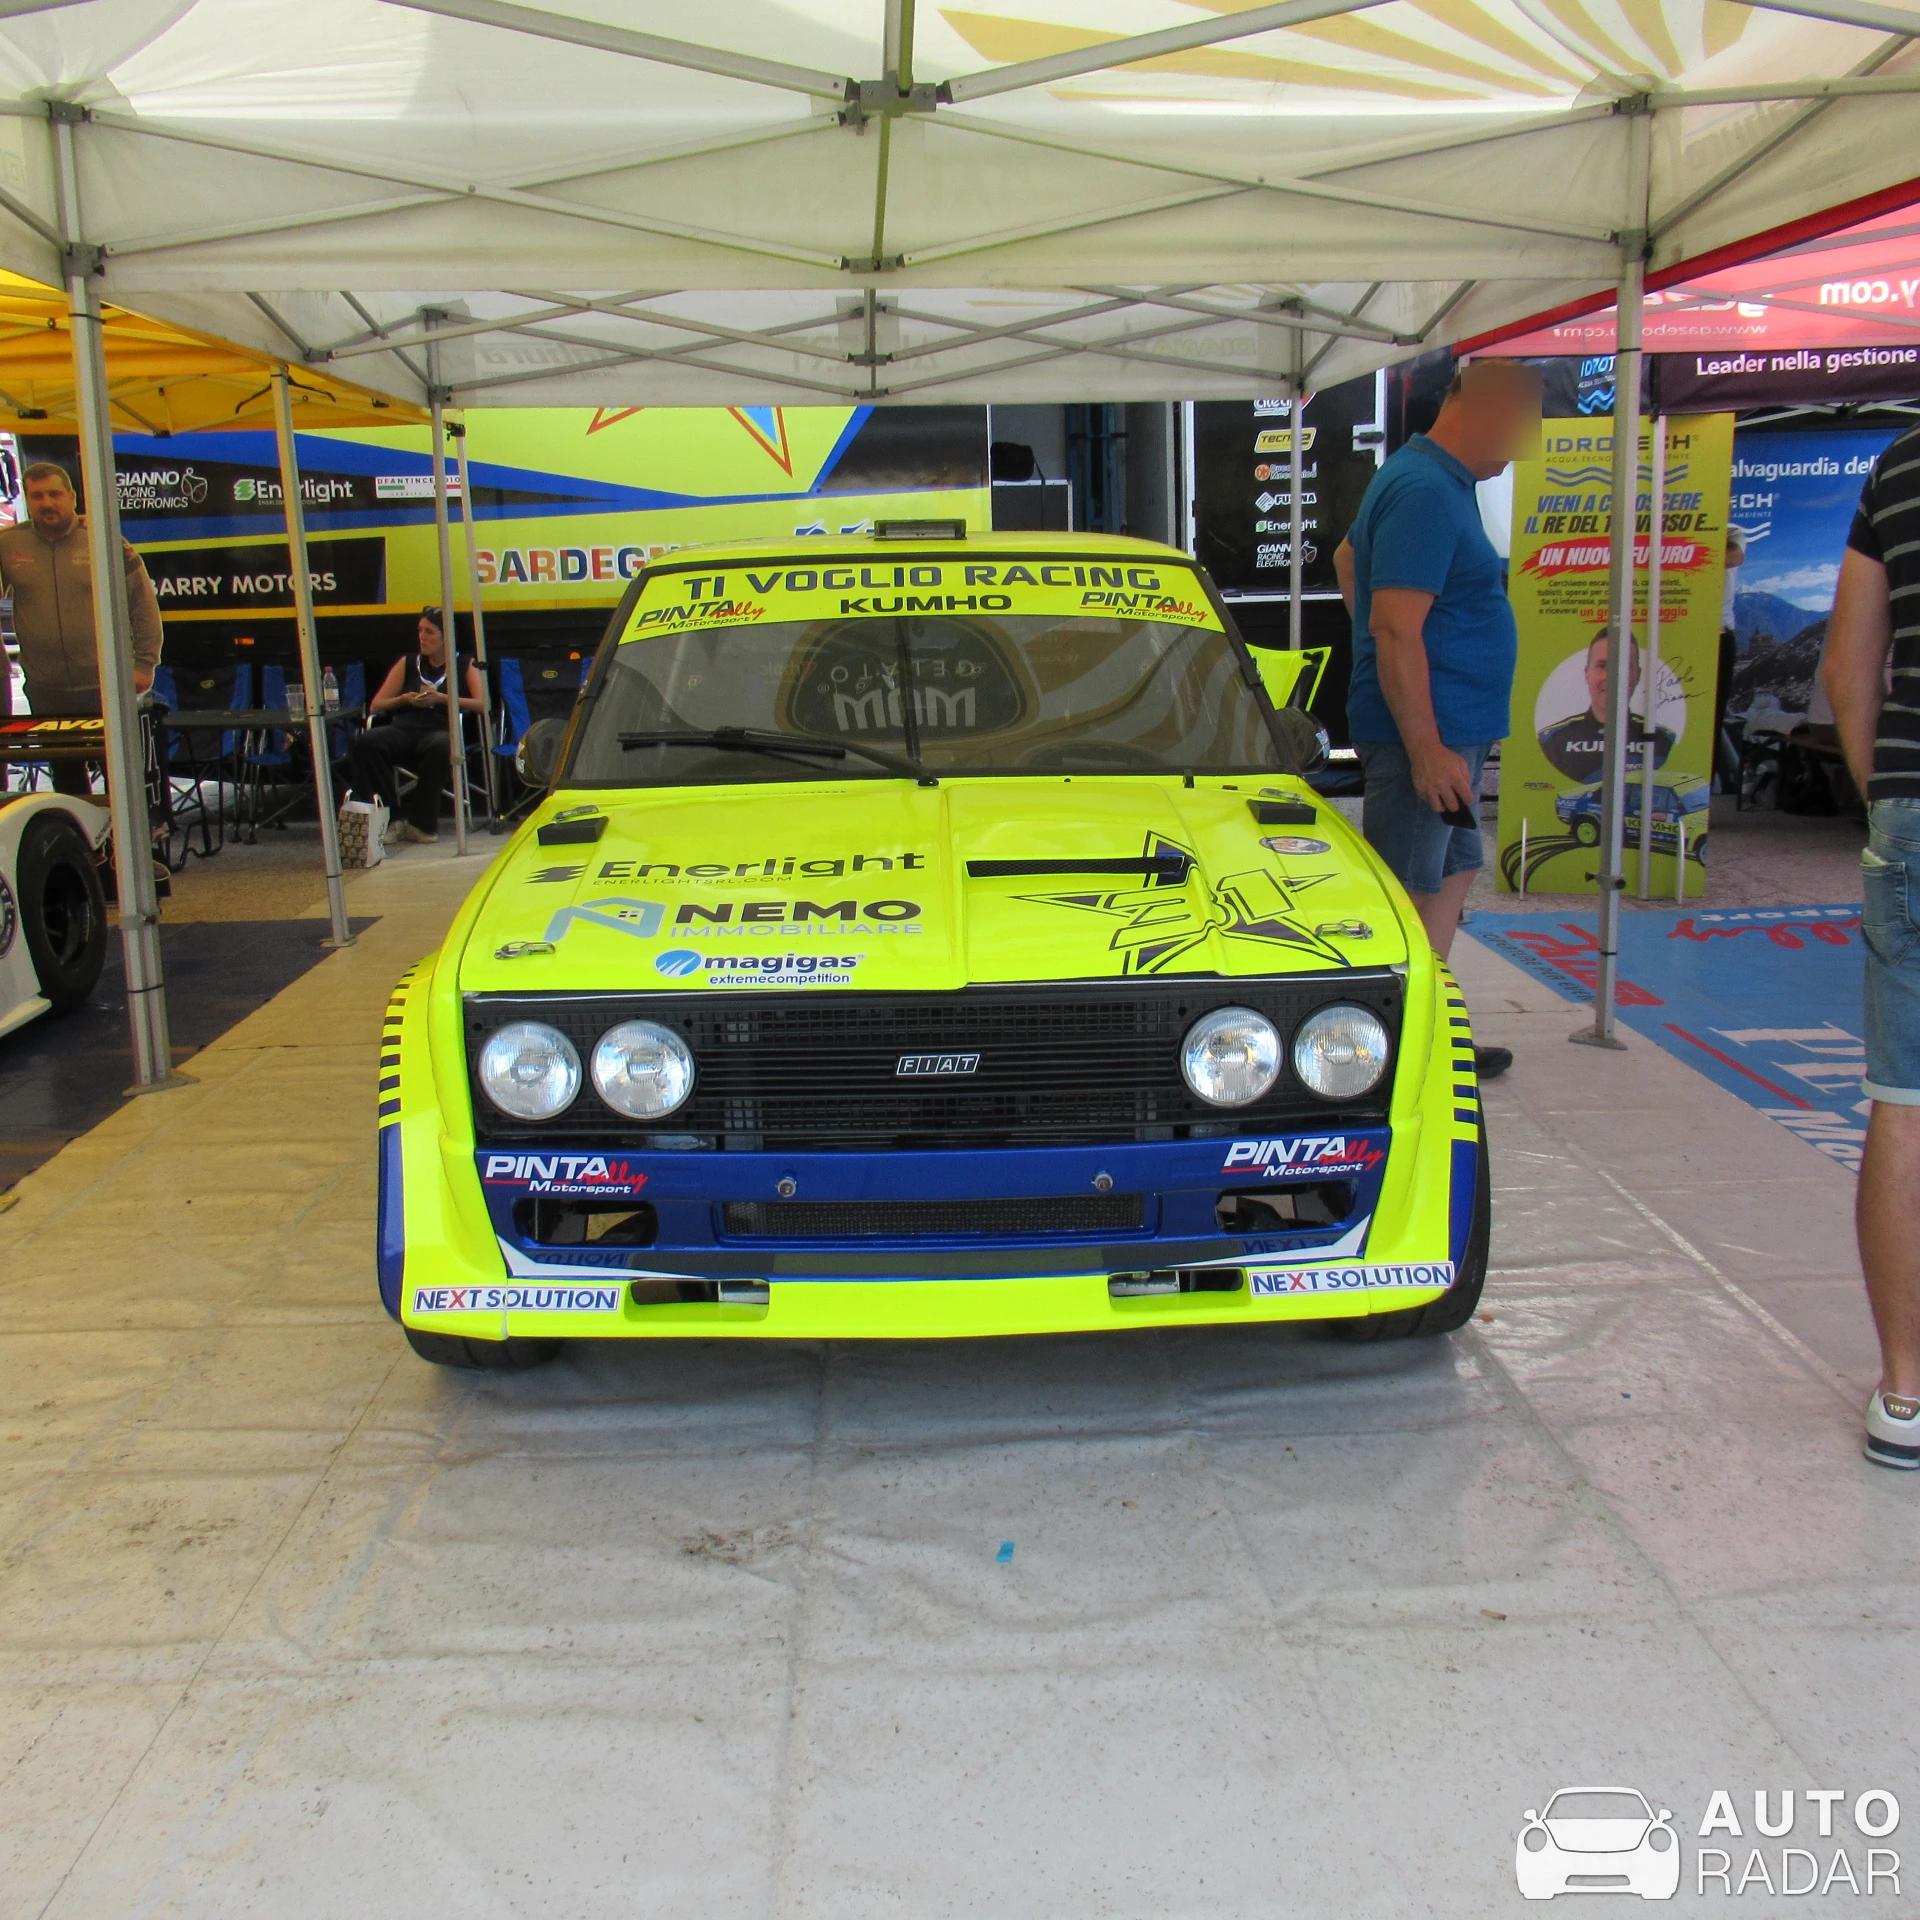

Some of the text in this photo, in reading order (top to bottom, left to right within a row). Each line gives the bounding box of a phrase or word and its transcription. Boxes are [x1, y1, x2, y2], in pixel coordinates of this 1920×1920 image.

[1697, 346, 1917, 377] Leader nella gestione
[1546, 435, 1691, 453] IDROEH
[1844, 455, 1880, 475] del
[115, 471, 180, 487] GIANNO
[117, 486, 156, 499] RACING
[257, 477, 354, 503] Enrlight
[1276, 493, 1315, 504] FUNA
[1537, 492, 1704, 513] VIENI A COSCERE
[1267, 518, 1317, 533] Energht
[1524, 515, 1539, 534] IL
[1542, 514, 1568, 534] RE
[1568, 514, 1600, 533] DEL
[1604, 513, 1693, 533] TVRSO
[1257, 544, 1292, 553] GIANN
[1538, 545, 1697, 567] UN NUOV FUURO
[476, 543, 660, 585] SARDEG
[1256, 559, 1304, 568] ELECTRONS
[683, 564, 1161, 601] TI VOGLIO RACING
[840, 594, 1013, 614] KUMHO
[1081, 591, 1179, 608] PINTA
[635, 599, 736, 628] PINTA
[1115, 607, 1197, 622] Motorsport
[1580, 608, 1594, 617] un
[666, 615, 750, 631] Motorsport
[28, 719, 105, 732] AVO
[1565, 740, 1646, 753] KUHO
[599, 852, 926, 879] Enerlight
[592, 875, 793, 886] ENERLIGHTSRL.COM
[674, 900, 922, 924] NEMO
[669, 922, 923, 938] IMMOBILIARE
[703, 952, 858, 974] magigas
[708, 973, 851, 986] extremecompetition
[902, 1056, 977, 1073] FIAT
[1223, 1137, 1384, 1171] PINTA rally
[486, 1156, 649, 1194] PINTA rally
[1262, 1162, 1364, 1178] Motorsport
[528, 1179, 632, 1195] Motorsport
[1251, 1265, 1452, 1294] NEXT SOLUTION
[416, 1288, 617, 1310] NEXT SOLUTION
[1889, 1403, 1912, 1415] 1973
